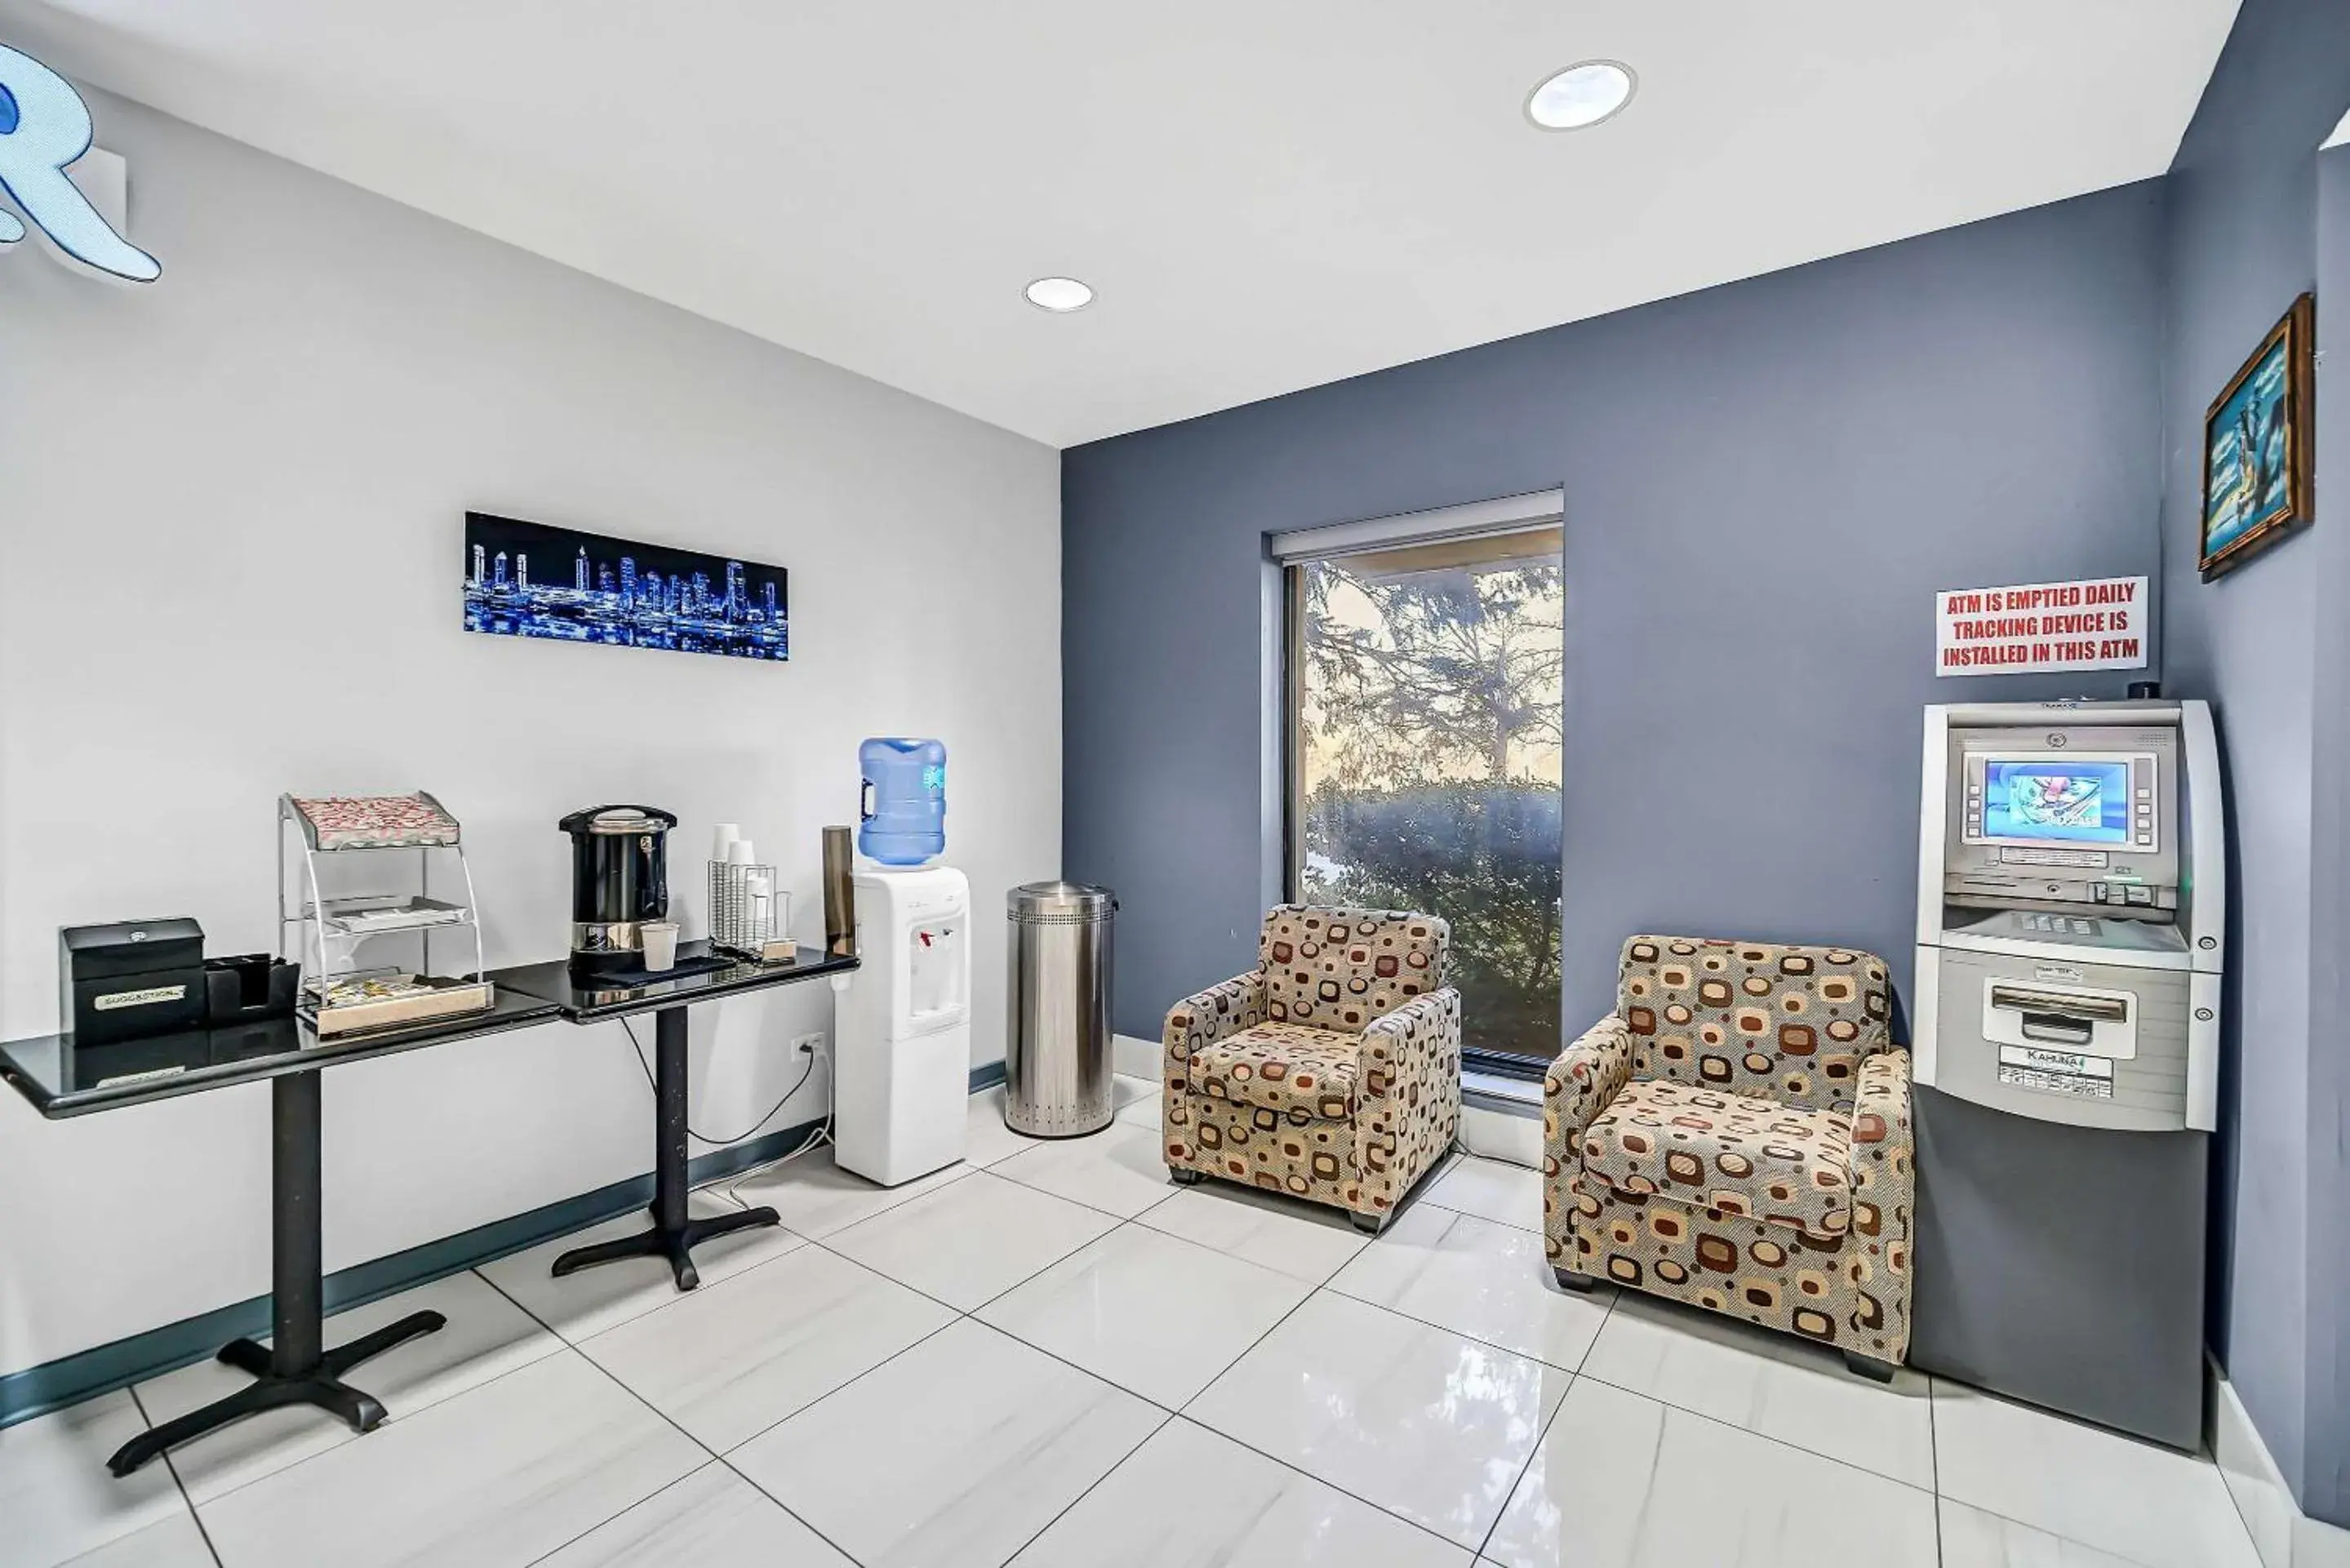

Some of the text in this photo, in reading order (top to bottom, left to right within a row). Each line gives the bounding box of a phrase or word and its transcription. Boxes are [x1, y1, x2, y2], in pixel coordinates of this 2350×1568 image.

[1948, 583, 2136, 615] ATM IS EMPTIED DAILY
[1953, 611, 2129, 639] TRACKING DEVICE IS
[1944, 638, 2139, 667] INSTALLED IN THIS ATM
